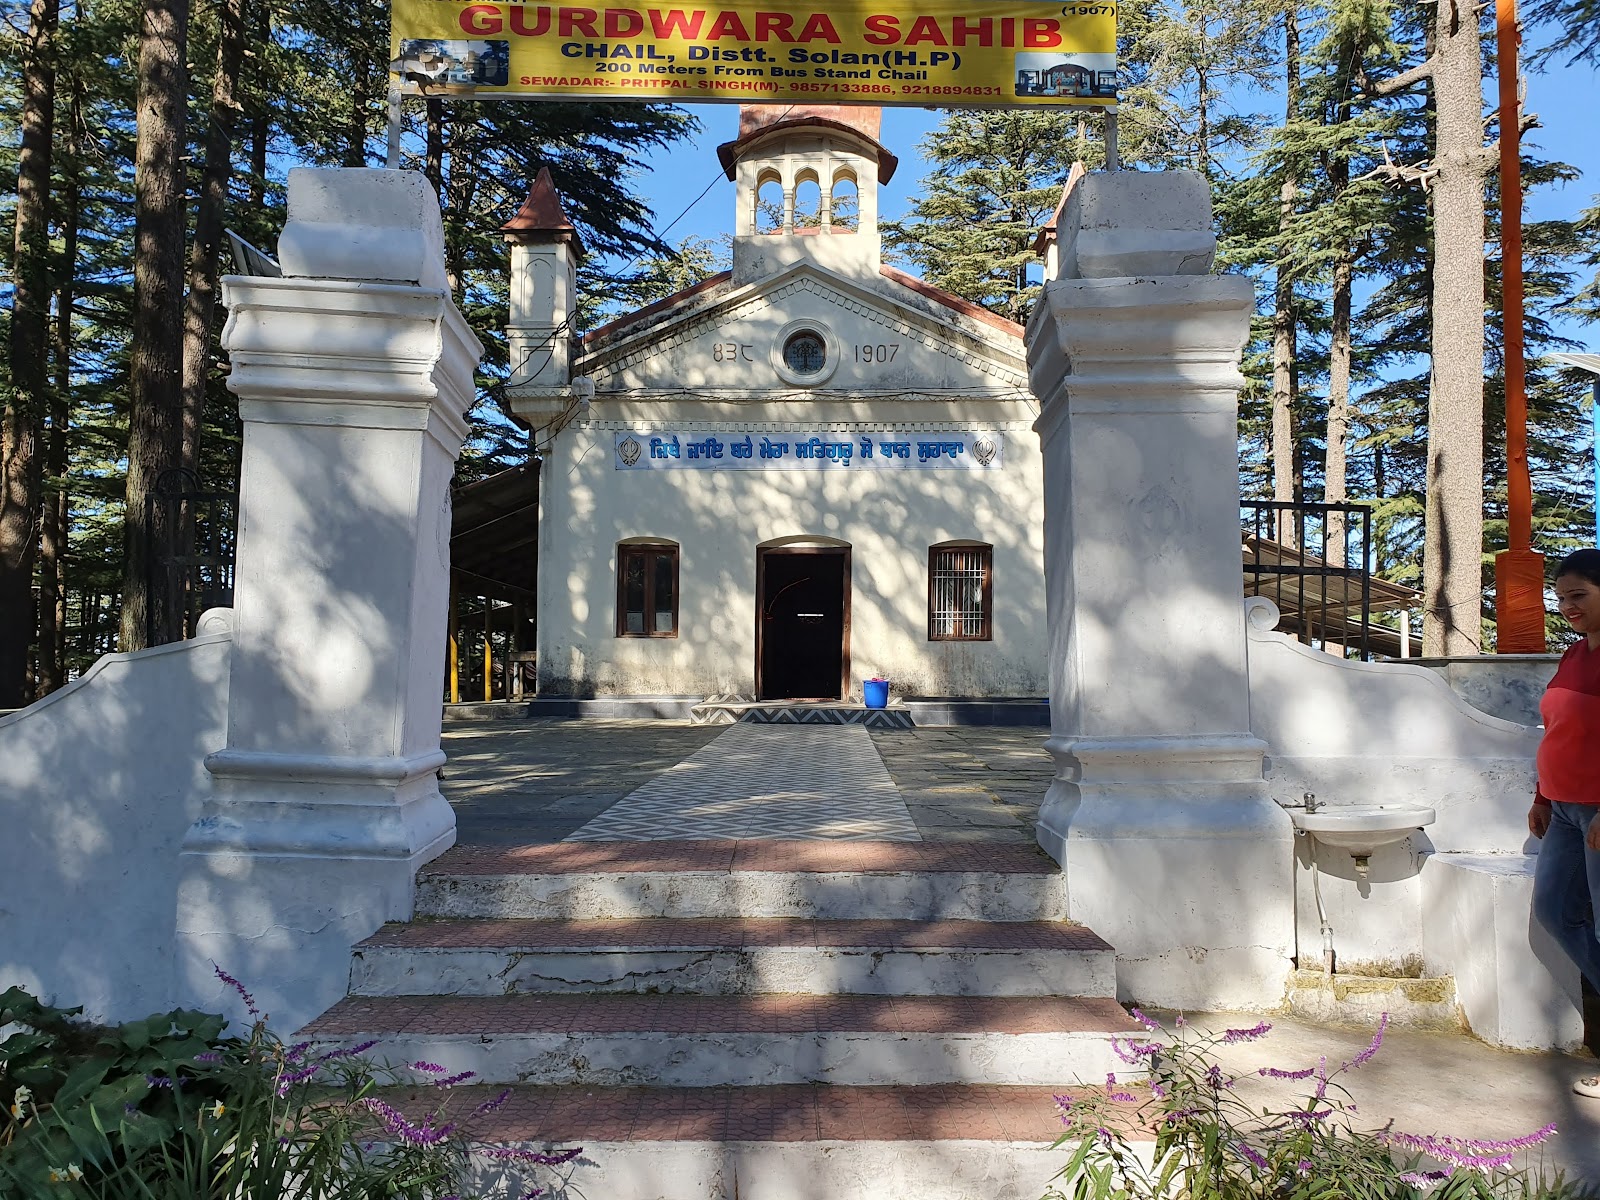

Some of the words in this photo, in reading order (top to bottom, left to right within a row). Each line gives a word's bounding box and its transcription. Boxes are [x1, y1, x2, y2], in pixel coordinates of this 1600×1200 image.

[1061, 6, 1115, 17] (1907)
[458, 5, 841, 44] GURDWARA
[863, 15, 1063, 48] SAHIB
[560, 42, 675, 62] CHAIL,
[688, 45, 776, 63] Distt.
[788, 49, 962, 71] Solan(H.P)
[595, 62, 632, 74] 200
[639, 63, 708, 75] Meters
[718, 64, 764, 77] From
[770, 67, 808, 78] Bus
[813, 68, 875, 80] Stand
[881, 69, 927, 81] Chail
[519, 76, 616, 88] SEWADAR:-
[621, 78, 692, 90] PRITPAL
[789, 82, 897, 96] 9857133886,
[902, 85, 1001, 97] 9218894831
[855, 344, 900, 363] 1907
[759, 437, 789, 459] ਮੇਰਾ
